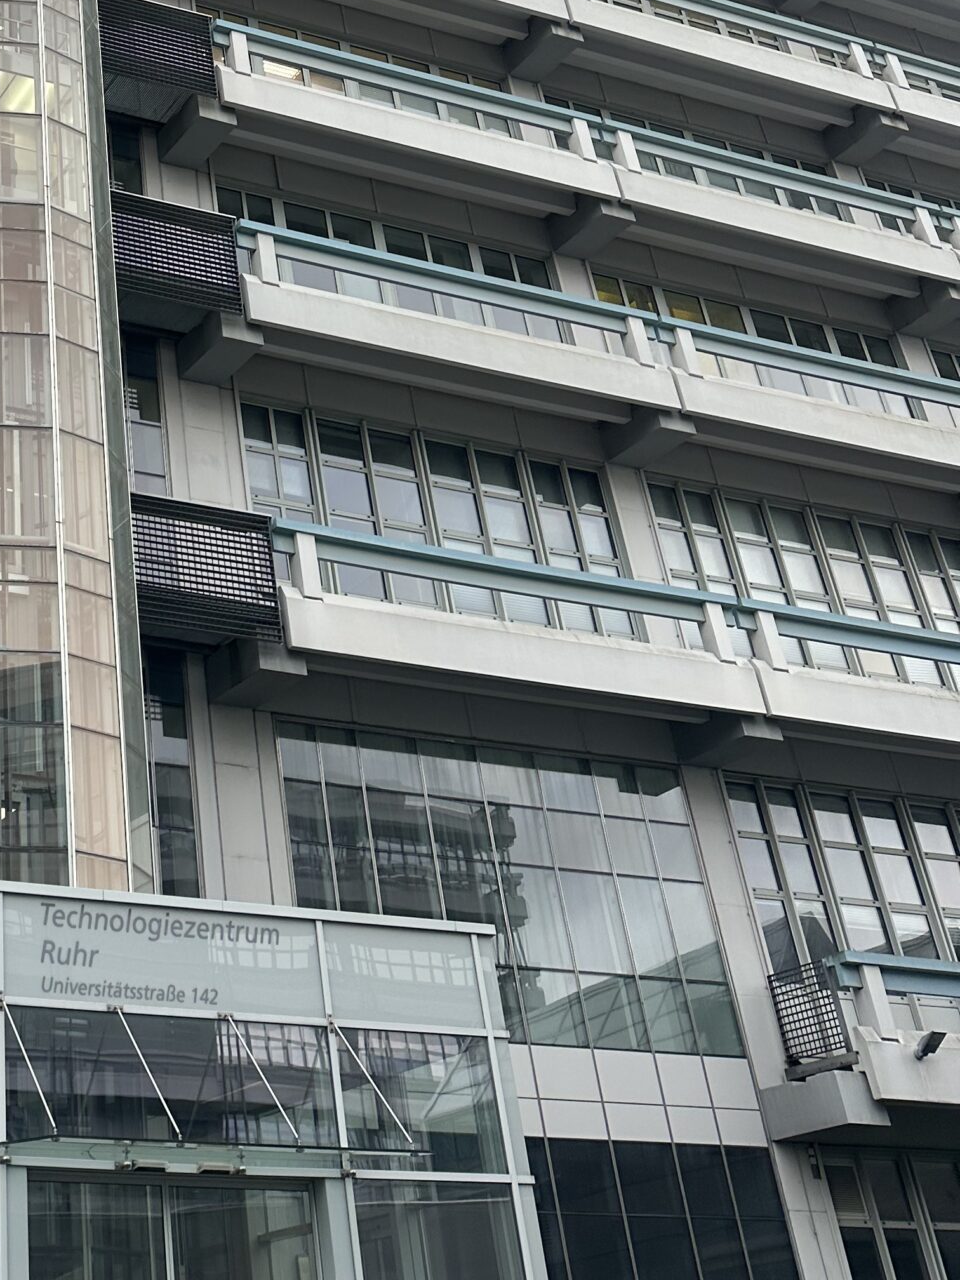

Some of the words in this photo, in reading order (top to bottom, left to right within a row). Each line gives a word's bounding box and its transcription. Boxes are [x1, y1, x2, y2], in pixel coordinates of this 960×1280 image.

[40, 902, 280, 945] Technologiezentrum
[40, 939, 99, 968] Ruhr
[41, 975, 186, 1003] Universitätsstraße
[191, 987, 219, 1006] 142
